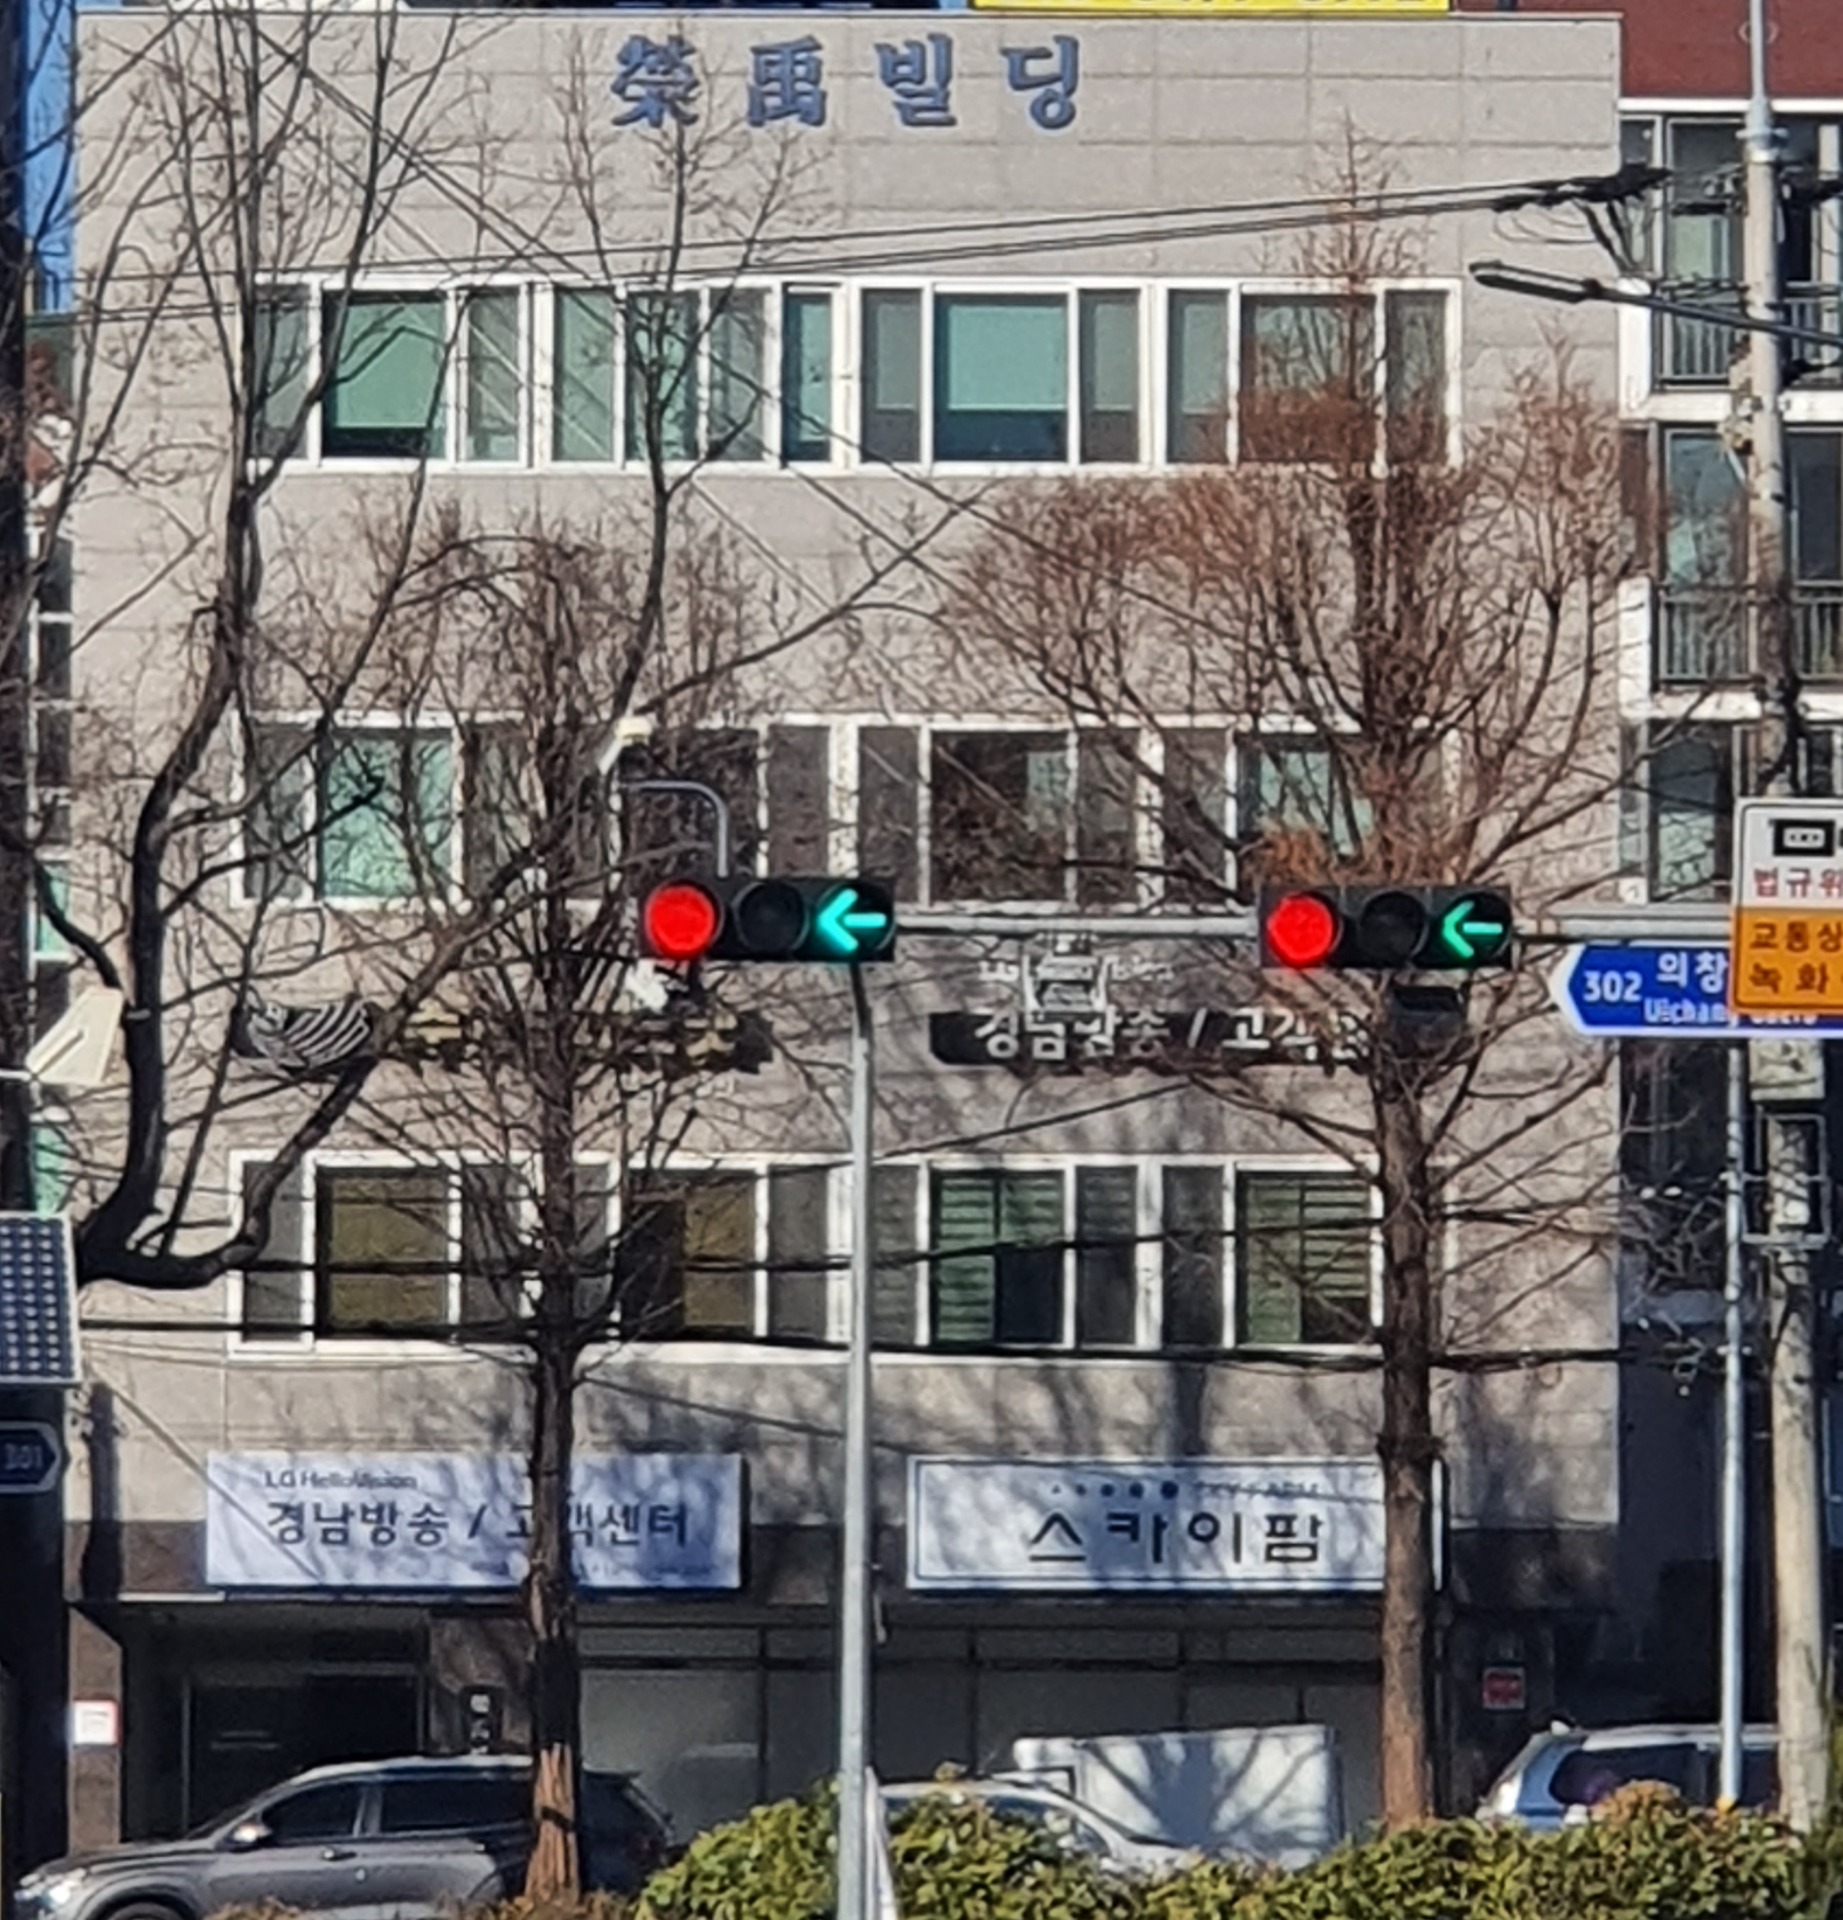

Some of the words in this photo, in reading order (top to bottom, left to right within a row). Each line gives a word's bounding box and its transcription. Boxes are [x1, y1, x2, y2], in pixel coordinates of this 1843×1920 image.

[1583, 970, 1643, 1002] 302
[268, 1501, 450, 1546] 경남방송
[1029, 1511, 1323, 1564] 스카이팜
